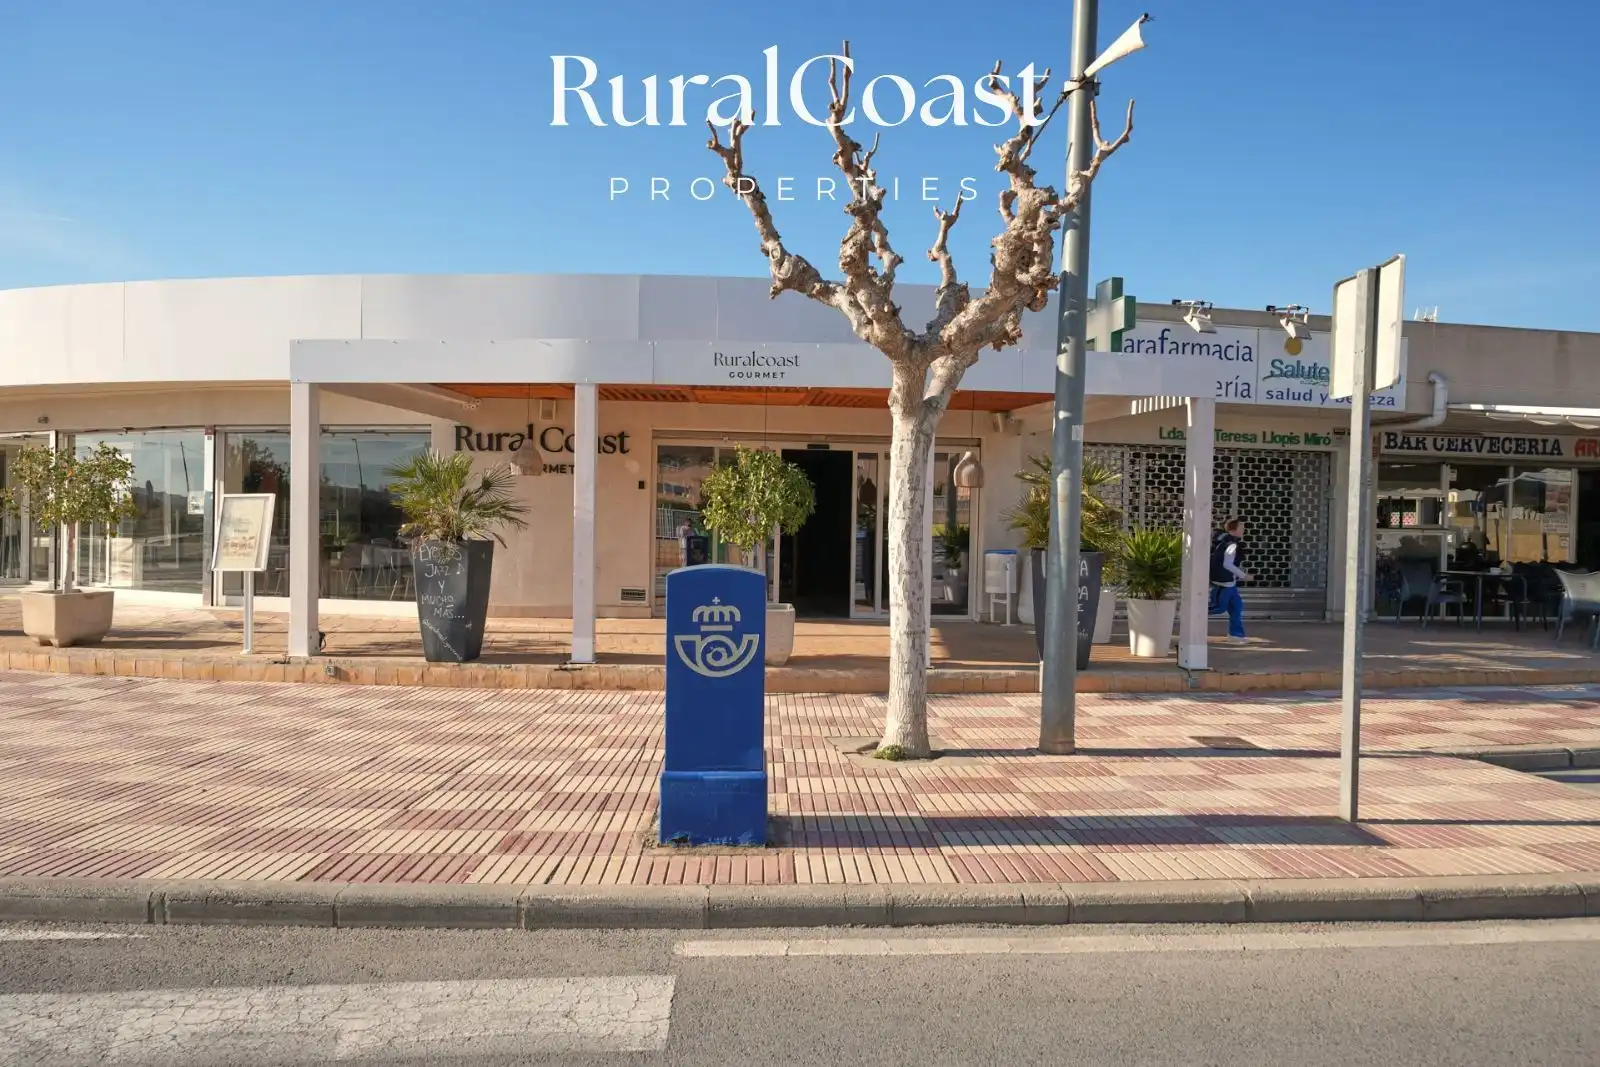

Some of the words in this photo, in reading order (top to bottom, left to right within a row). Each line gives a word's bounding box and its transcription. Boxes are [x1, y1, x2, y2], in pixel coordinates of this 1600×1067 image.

[1123, 328, 1253, 362] arafarmacia
[713, 350, 800, 367] Ruralcoast
[728, 371, 786, 379] GOURMET
[1265, 388, 1313, 402] salud
[1319, 392, 1329, 405] y
[540, 426, 631, 454] Cost
[1214, 429, 1258, 443] Teresa
[1262, 431, 1300, 447] Llopis
[1304, 432, 1331, 446] Miró
[1384, 431, 1427, 450] BAR
[1433, 436, 1563, 456] CERVECERIA
[1574, 438, 1600, 458] AR
